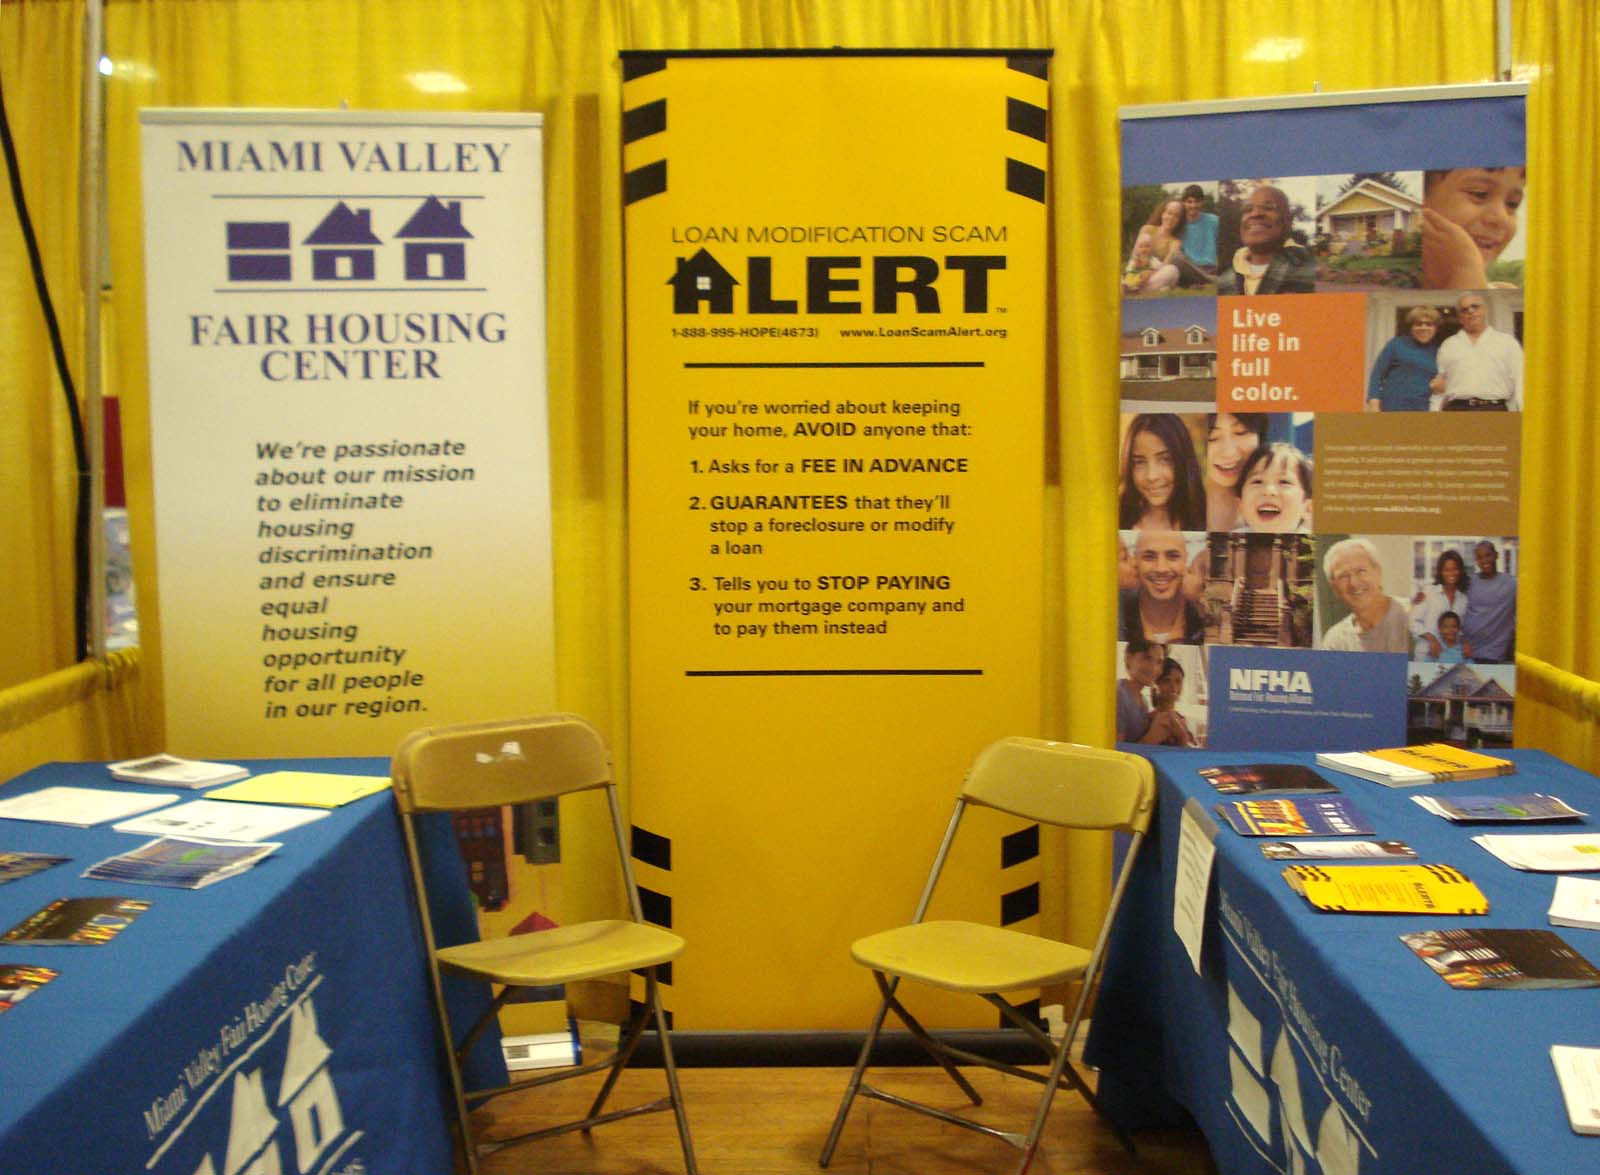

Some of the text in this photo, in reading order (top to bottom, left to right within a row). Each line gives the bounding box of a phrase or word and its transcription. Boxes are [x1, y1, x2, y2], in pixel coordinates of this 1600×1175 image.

[177, 141, 511, 173] MIAMI VALLEY
[672, 226, 1007, 244] LOAN MODIFICATION SCAM
[666, 247, 1007, 314] ALERT
[1231, 308, 1281, 328] Live
[190, 312, 507, 346] FAIR HOUSING
[839, 326, 1007, 338] www.LoanScamAlert.org
[1231, 332, 1300, 352] life in
[260, 348, 442, 382] CENTER
[1231, 357, 1271, 377] full
[1231, 381, 1299, 401] color.
[688, 399, 961, 418] If you're worried about keeping
[688, 422, 973, 440] your home, AVOID anyone that:
[256, 440, 466, 461] We're passionate
[256, 465, 475, 486] about our mission
[690, 458, 969, 474] 1. Asks for a FEE IN ADVANCE
[257, 492, 404, 512] to eliminate
[689, 495, 950, 513] 2. GUARANTEES that they'll
[258, 519, 354, 539] housing
[710, 518, 955, 536] stop a foreclosure or modify
[259, 544, 432, 564] discrimination
[710, 540, 763, 555] a loan
[259, 571, 396, 590] and ensure
[690, 575, 951, 594] 3. Tells you to STOP PAYING
[261, 597, 328, 618] equal
[714, 598, 965, 617] your mortgage company and
[262, 623, 358, 642] housing
[714, 620, 887, 638] to pay them instead
[263, 646, 406, 670] opportunity
[264, 670, 424, 693] for all people
[1230, 668, 1313, 693] NFHA
[265, 697, 428, 718] in our region.
